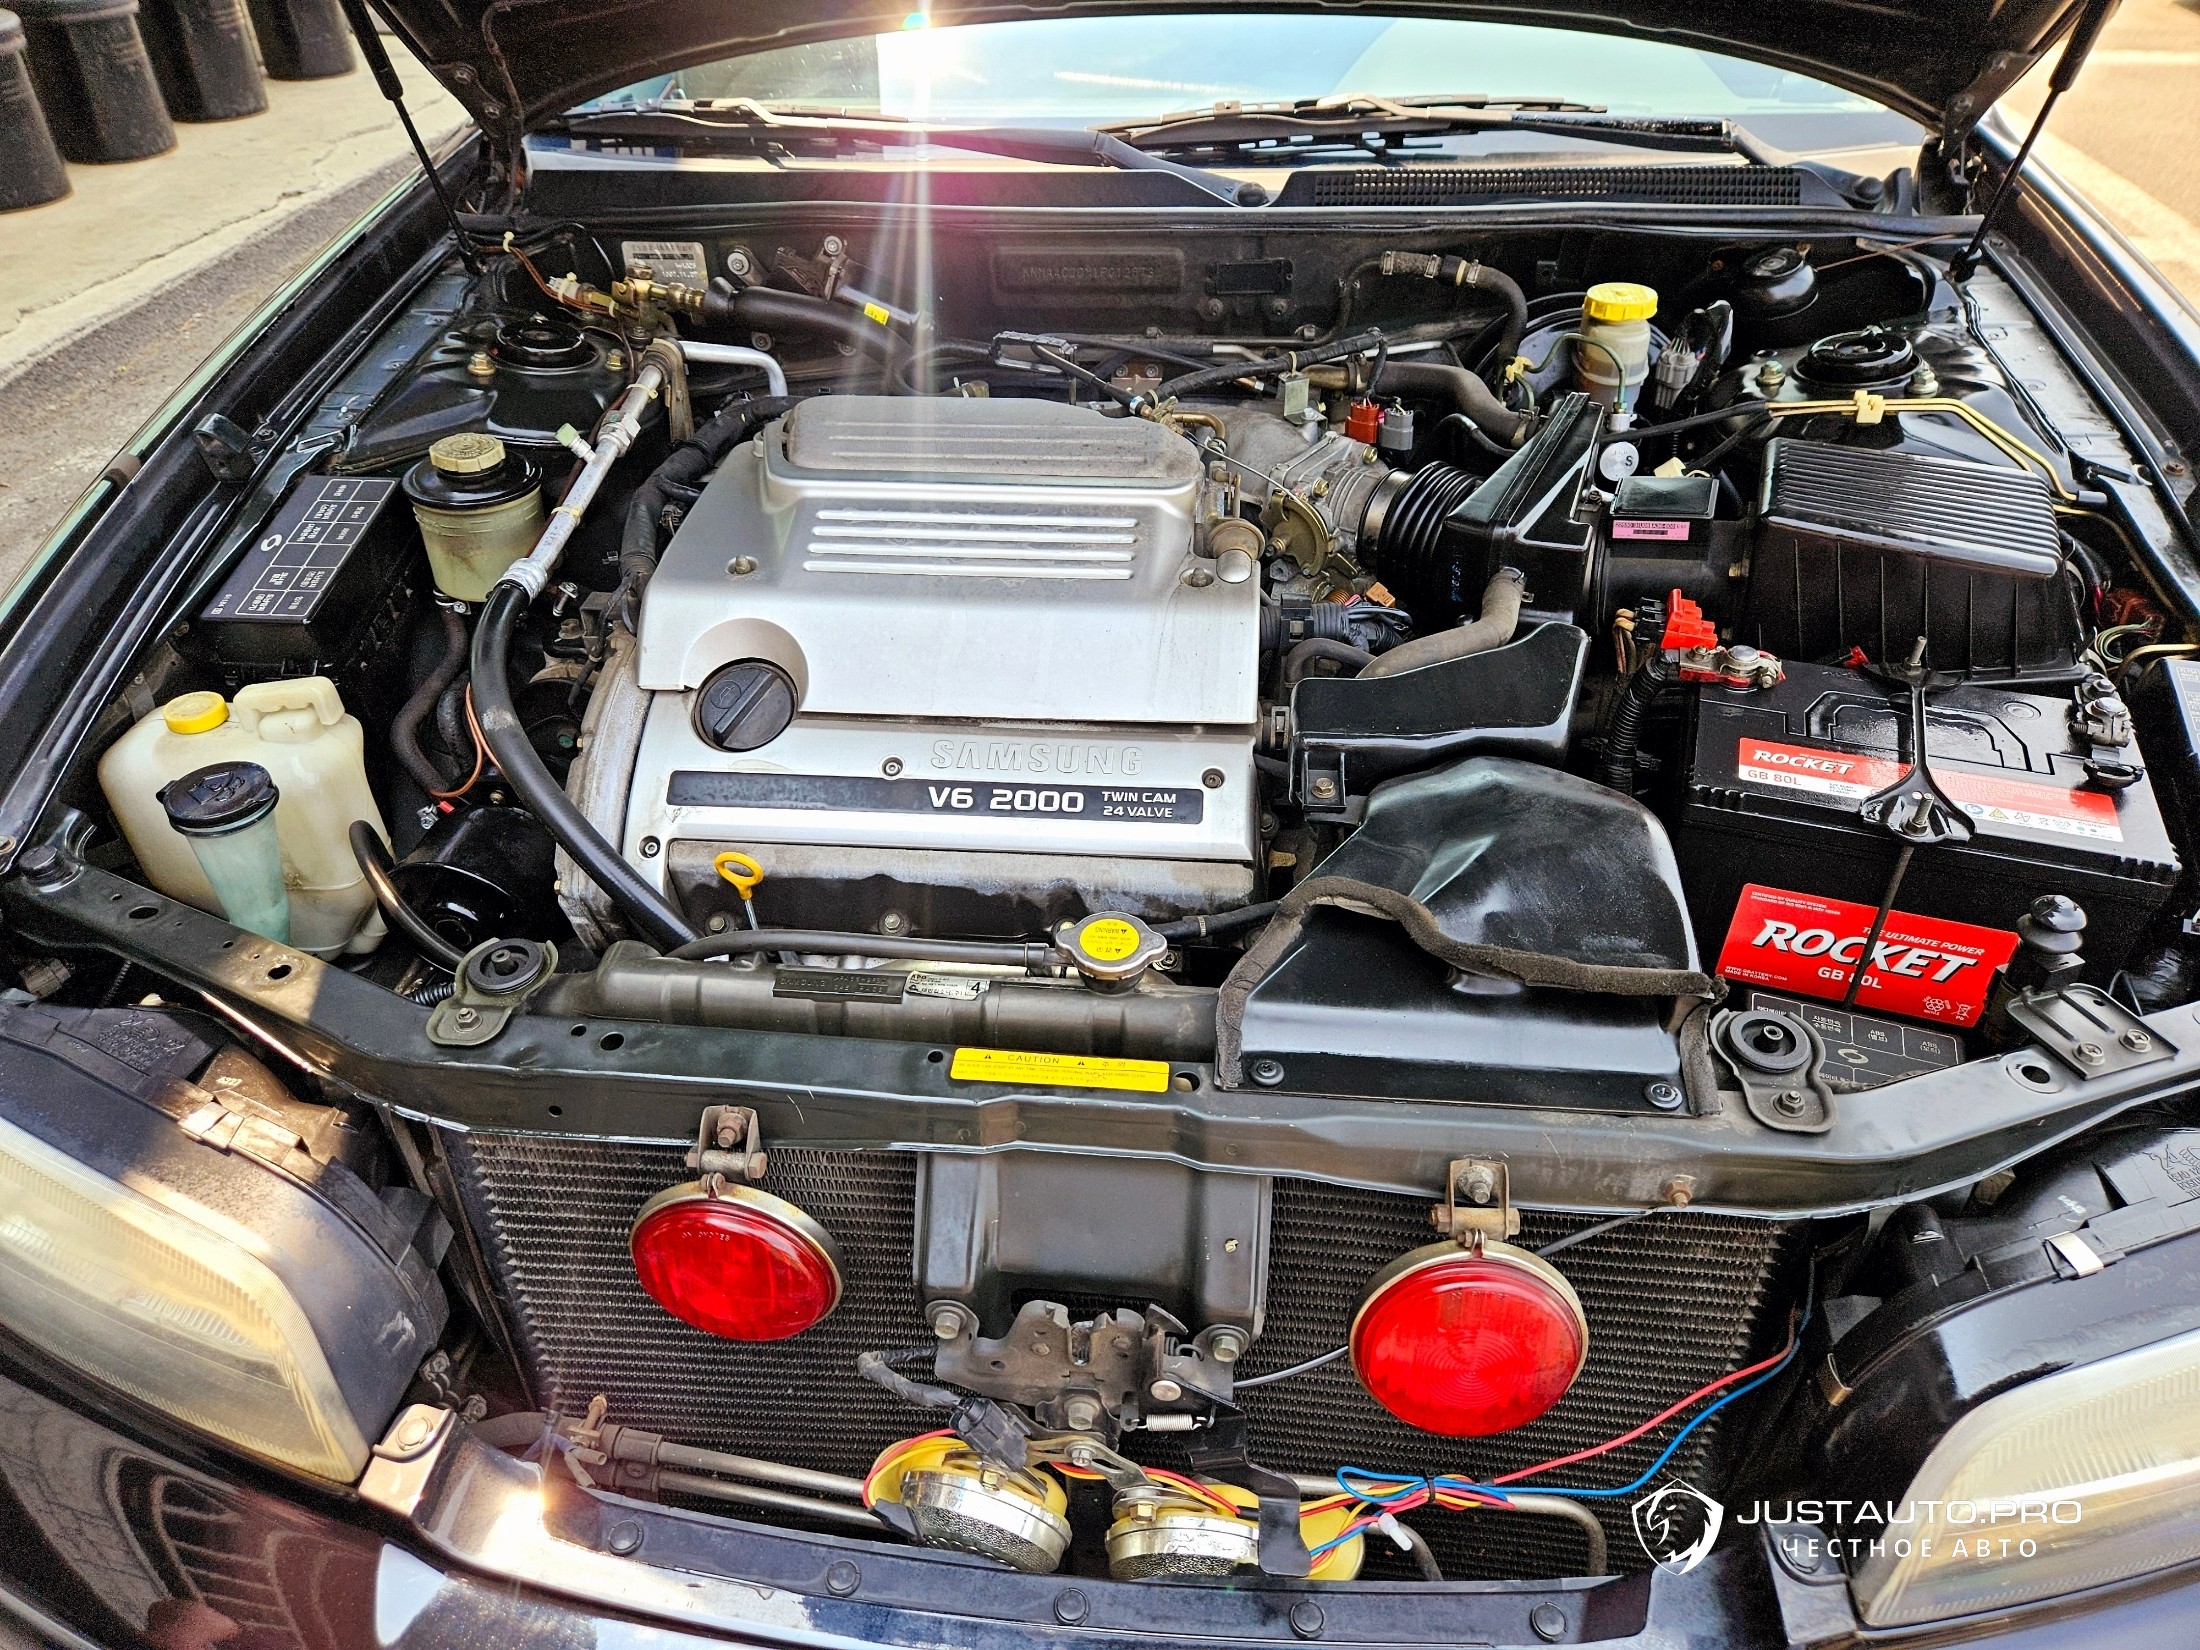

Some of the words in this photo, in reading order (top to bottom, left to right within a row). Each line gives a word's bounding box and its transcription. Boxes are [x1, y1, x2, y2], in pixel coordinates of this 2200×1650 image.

[1625, 455, 1633, 467] S
[930, 739, 1145, 776] SAMSUNG
[1752, 749, 1854, 775] ROCKET
[1747, 769, 1769, 780] GB
[1773, 773, 1802, 786] 80L
[928, 786, 974, 809] V6
[989, 788, 1085, 813] 2000
[1102, 791, 1138, 803] TWIN
[1142, 792, 1177, 804] CAM
[1102, 805, 1125, 816] 24
[1127, 806, 1174, 819] VALVE
[1751, 918, 1978, 983] ROCKET
[1885, 931, 1940, 948] ULTIMATE
[1940, 942, 1986, 957] POWER
[1724, 968, 1742, 976] MADE
[1817, 966, 1845, 981] GB
[971, 981, 981, 993] 4
[1922, 1041, 1938, 1049] ABS
[1007, 1054, 1060, 1064] CAUTION
